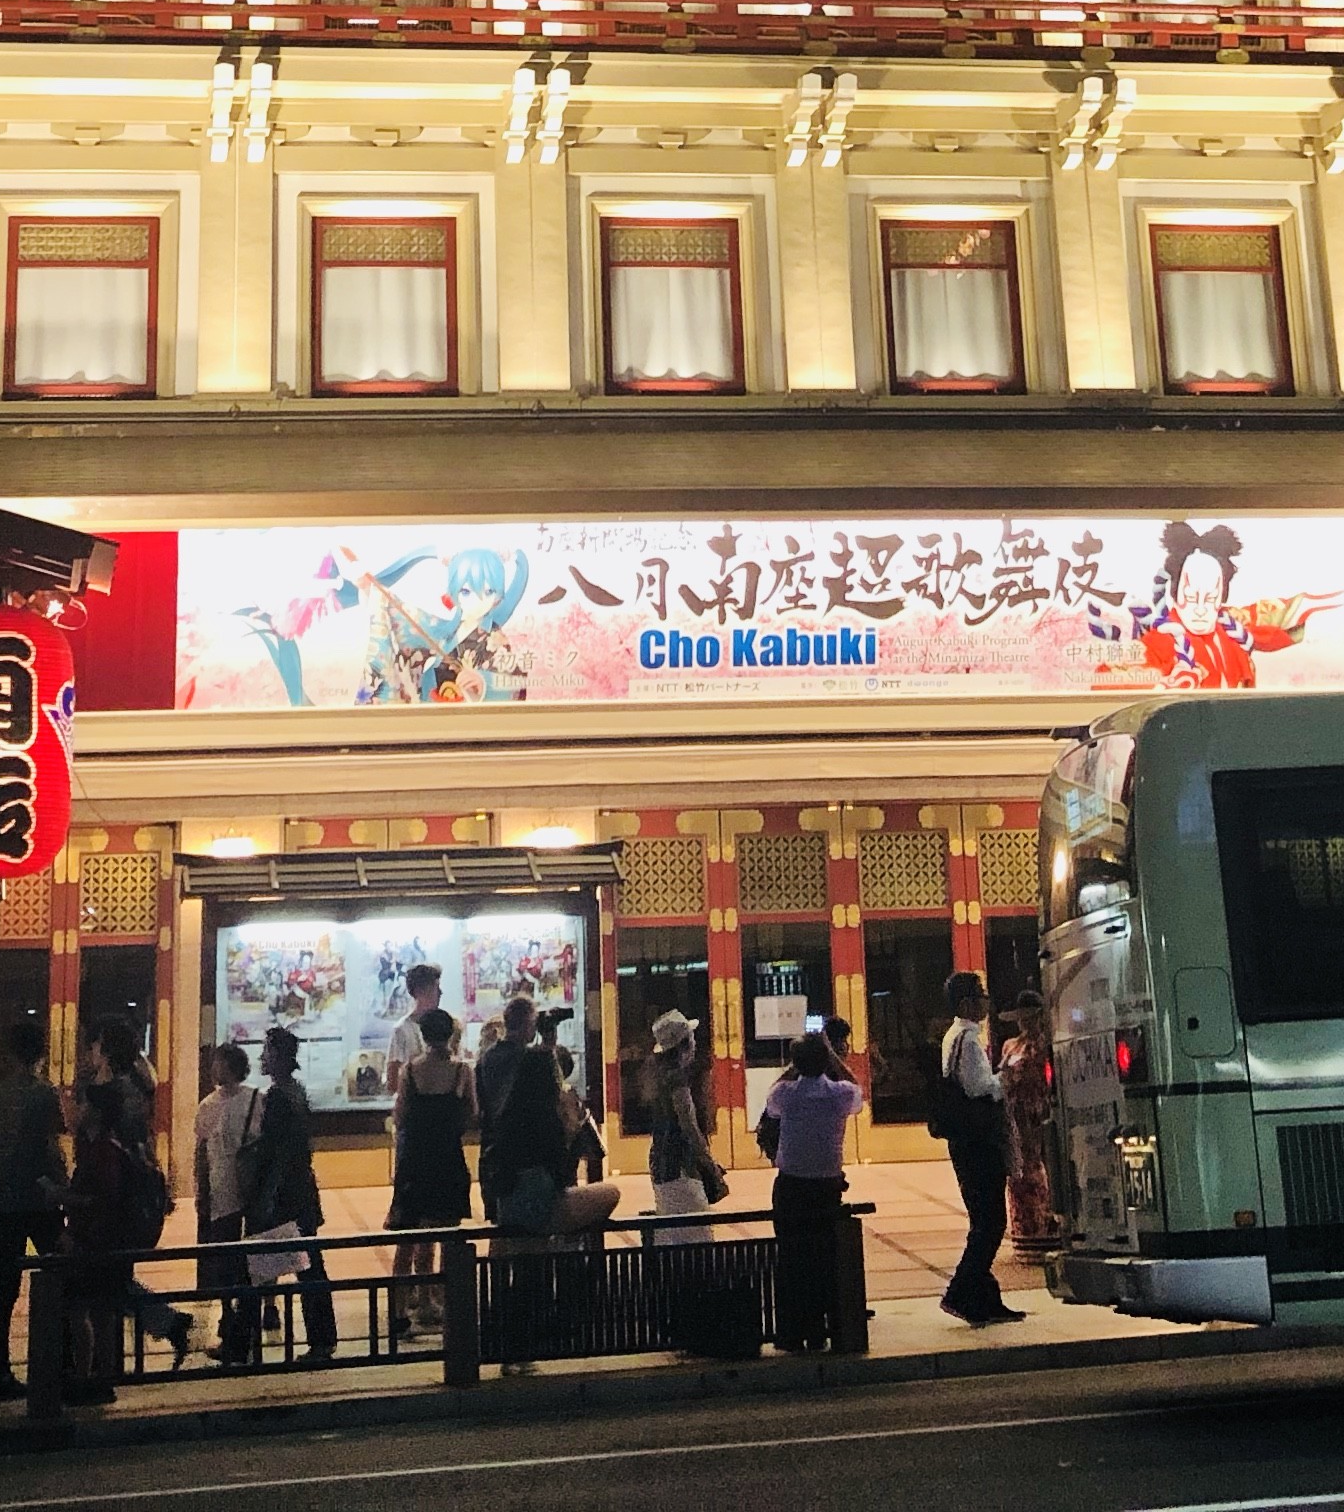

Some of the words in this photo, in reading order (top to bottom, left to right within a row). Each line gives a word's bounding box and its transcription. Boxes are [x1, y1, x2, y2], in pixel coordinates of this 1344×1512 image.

[538, 517, 1127, 626] 八月南座超歌舞伎
[639, 629, 721, 669] Cho
[732, 627, 877, 667] Kabuki
[893, 635, 935, 649] August
[937, 633, 979, 647] Kabuki
[982, 634, 1030, 649] Program
[497, 650, 579, 672] 初音ミク
[904, 652, 926, 664] the
[928, 652, 986, 664] Minamiza
[990, 651, 1030, 664] Theatre
[1065, 644, 1145, 664] 中村獅童
[494, 673, 546, 687] Hatsune
[551, 673, 585, 686] Miku
[881, 680, 902, 689] NTT
[1064, 671, 1125, 685] Nakamura
